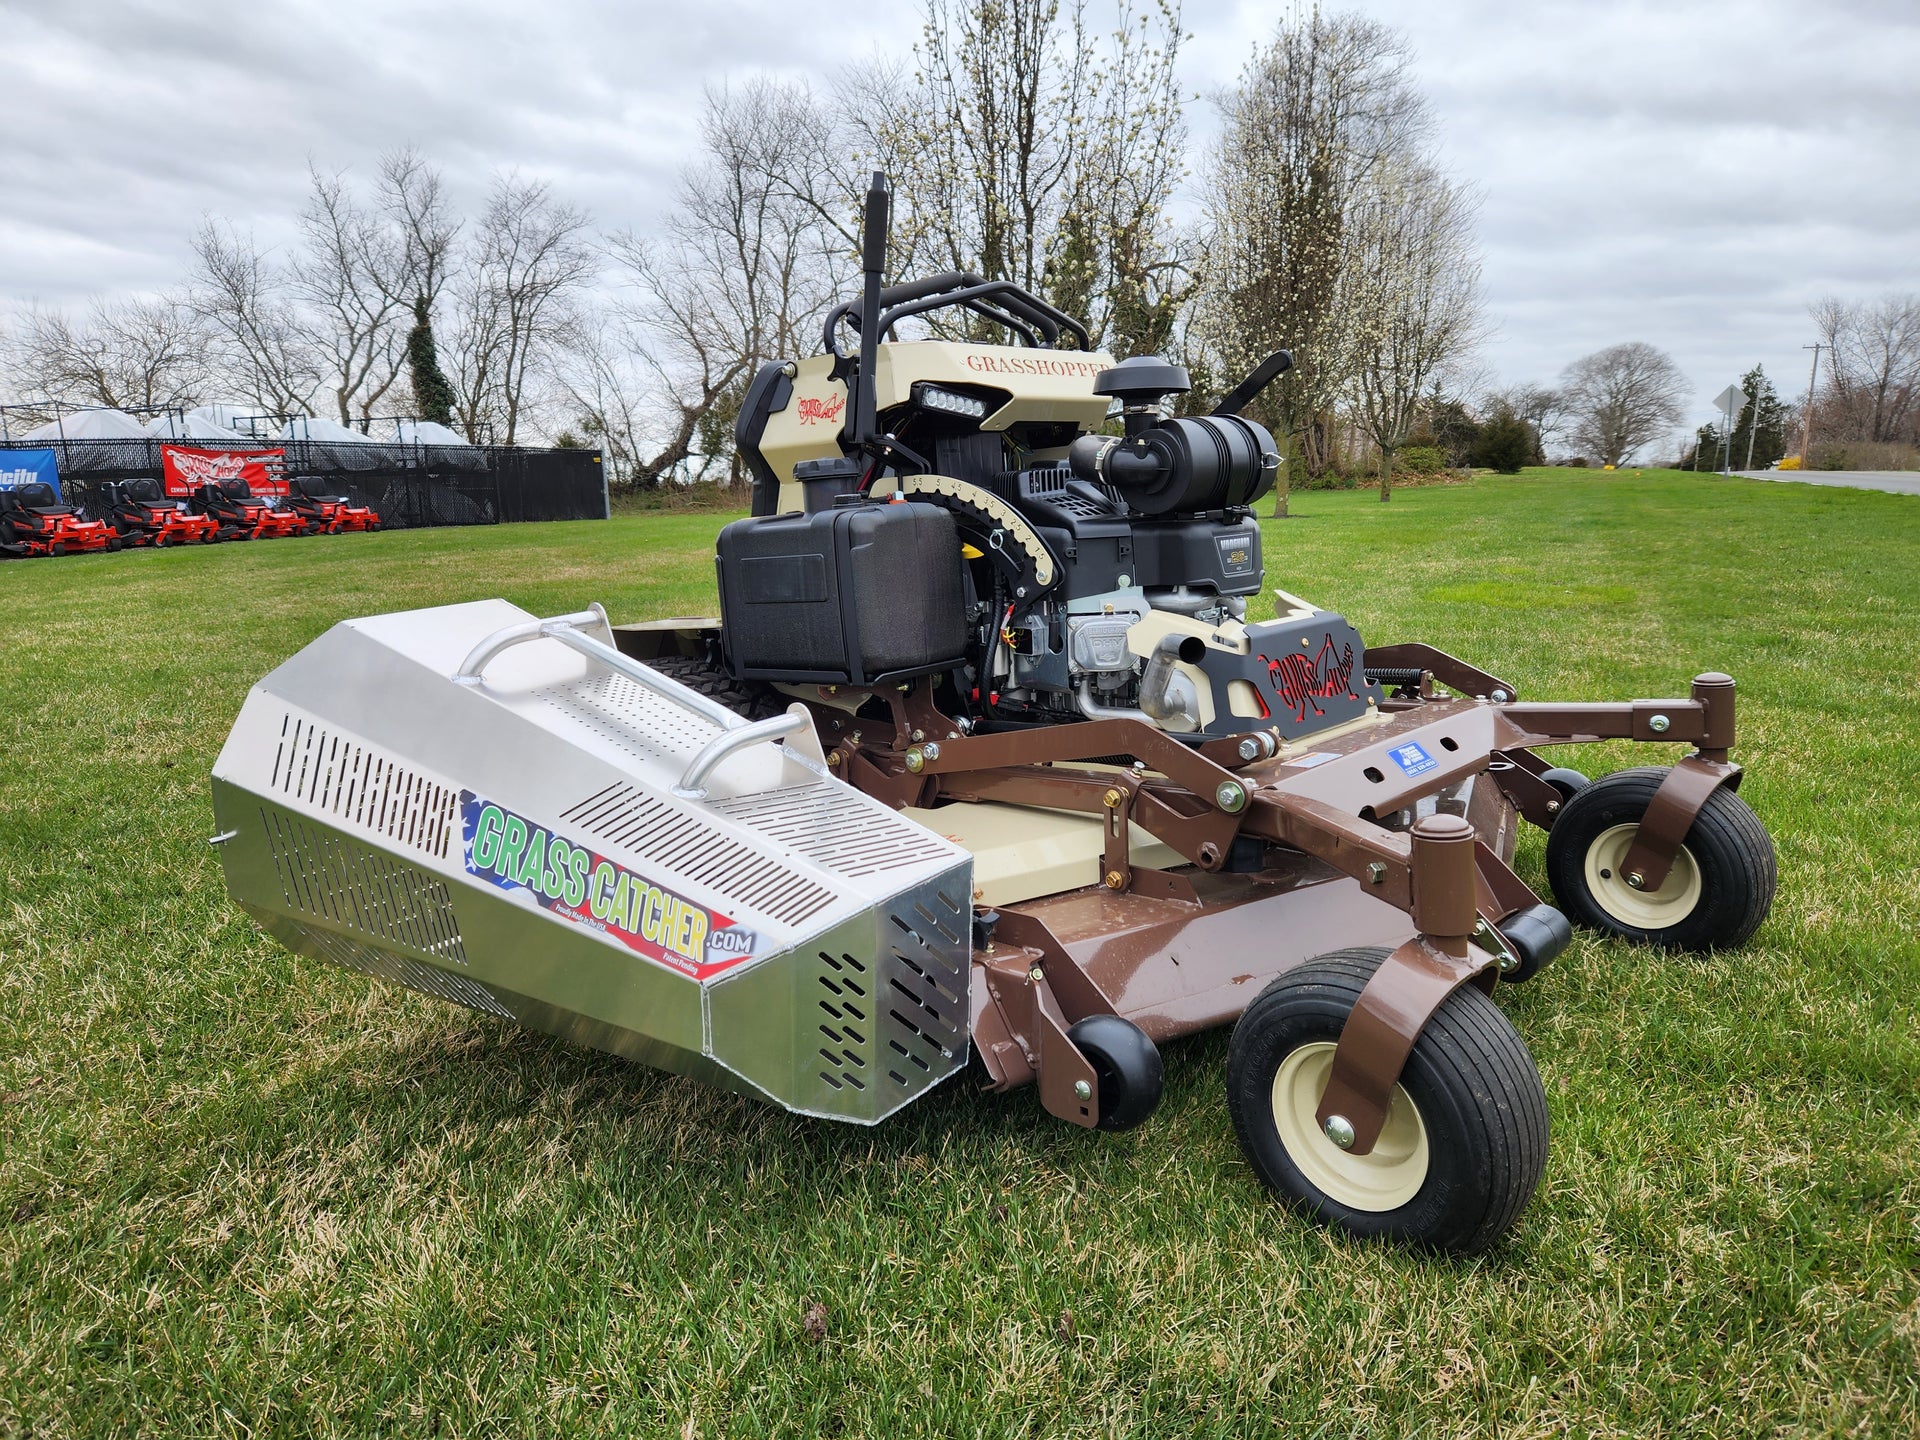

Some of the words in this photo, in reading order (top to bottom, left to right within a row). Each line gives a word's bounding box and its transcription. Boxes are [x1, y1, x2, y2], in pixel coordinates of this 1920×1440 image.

[912, 478, 922, 486] 5.5
[936, 478, 941, 486] 5
[984, 496, 994, 508] 3.5
[1000, 508, 1006, 516] 3
[473, 804, 590, 908] GRASS
[590, 862, 709, 963] CATCHER
[556, 904, 572, 918] Proudly
[572, 911, 584, 922] Made
[588, 918, 597, 927] The
[597, 922, 606, 931] USA
[662, 952, 680, 966] Patent
[678, 960, 698, 976] Pending
